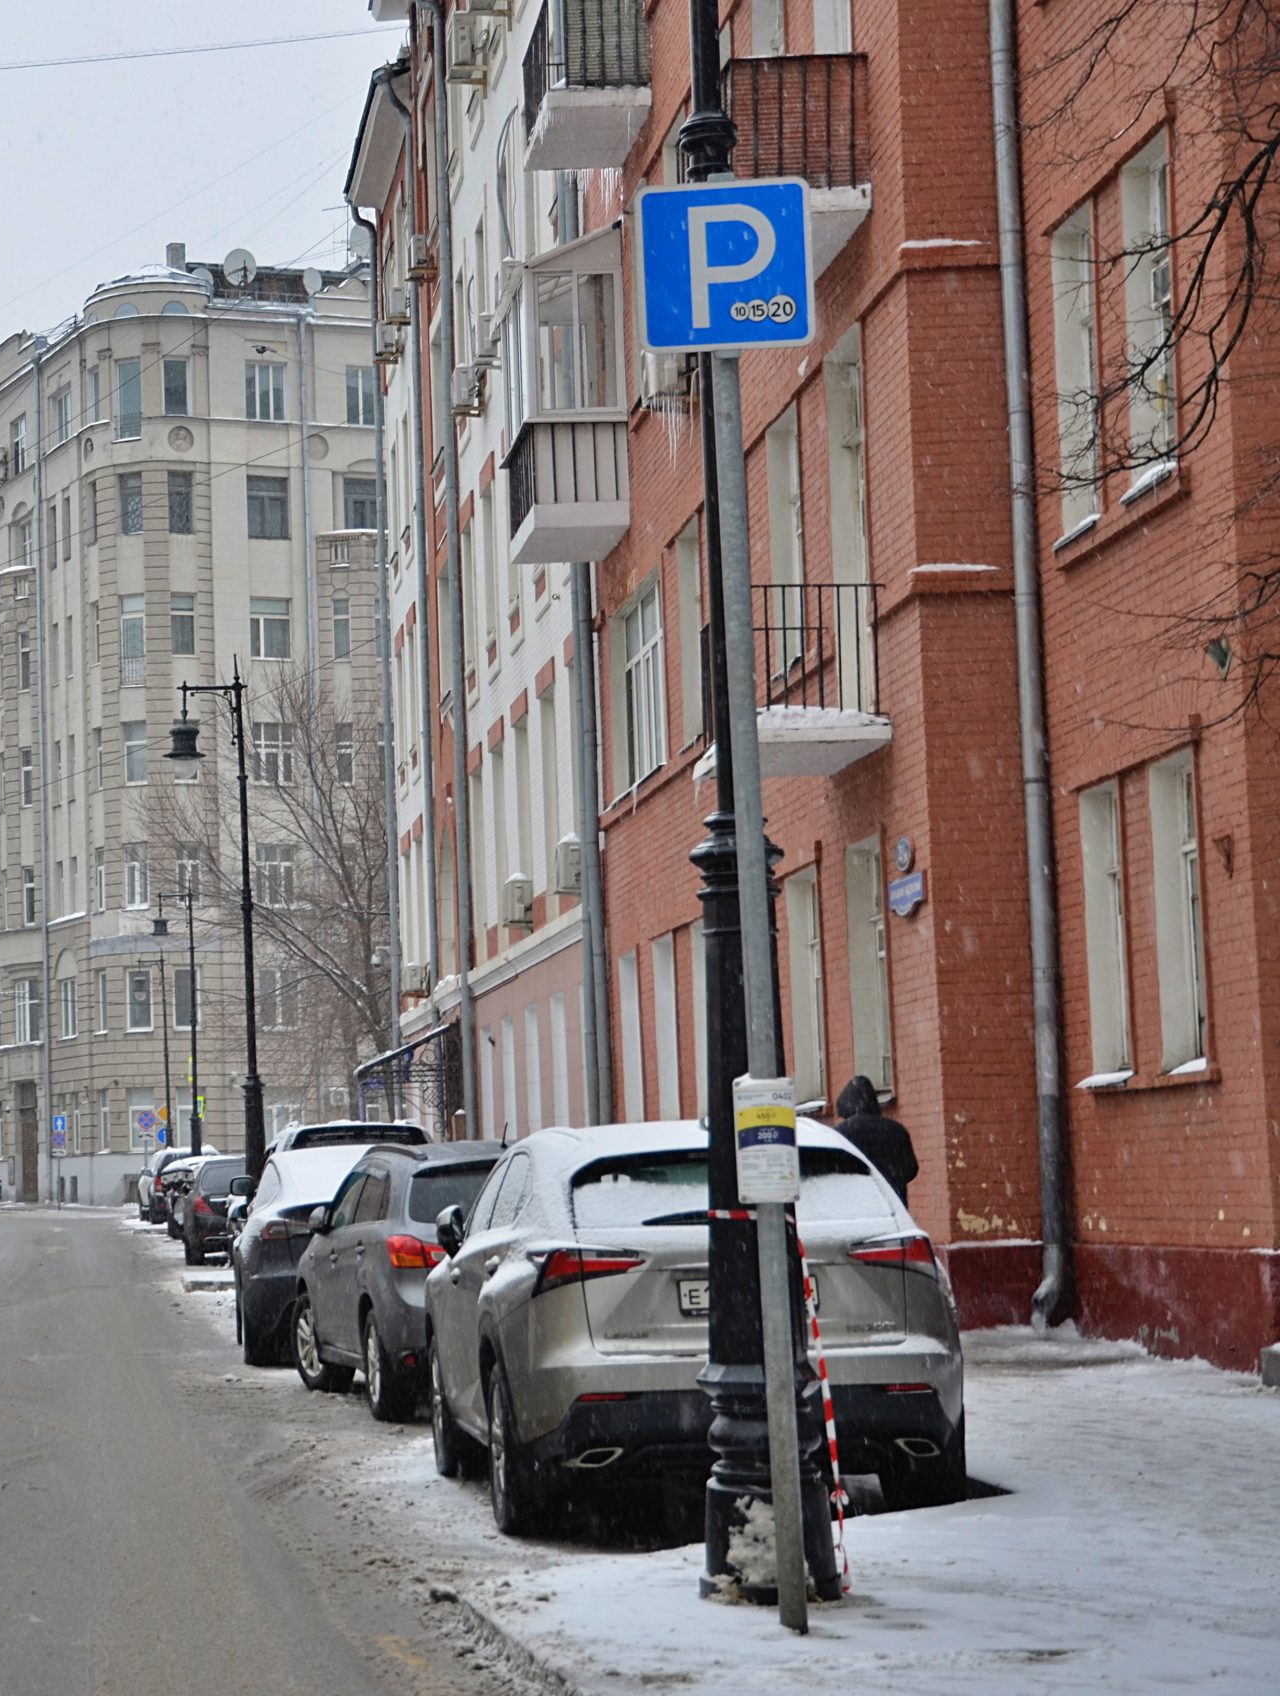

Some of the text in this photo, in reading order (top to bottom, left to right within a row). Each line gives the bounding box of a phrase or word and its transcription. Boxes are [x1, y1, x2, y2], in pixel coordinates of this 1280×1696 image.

[688, 203, 777, 329] P
[734, 302, 793, 317] 10 15 20
